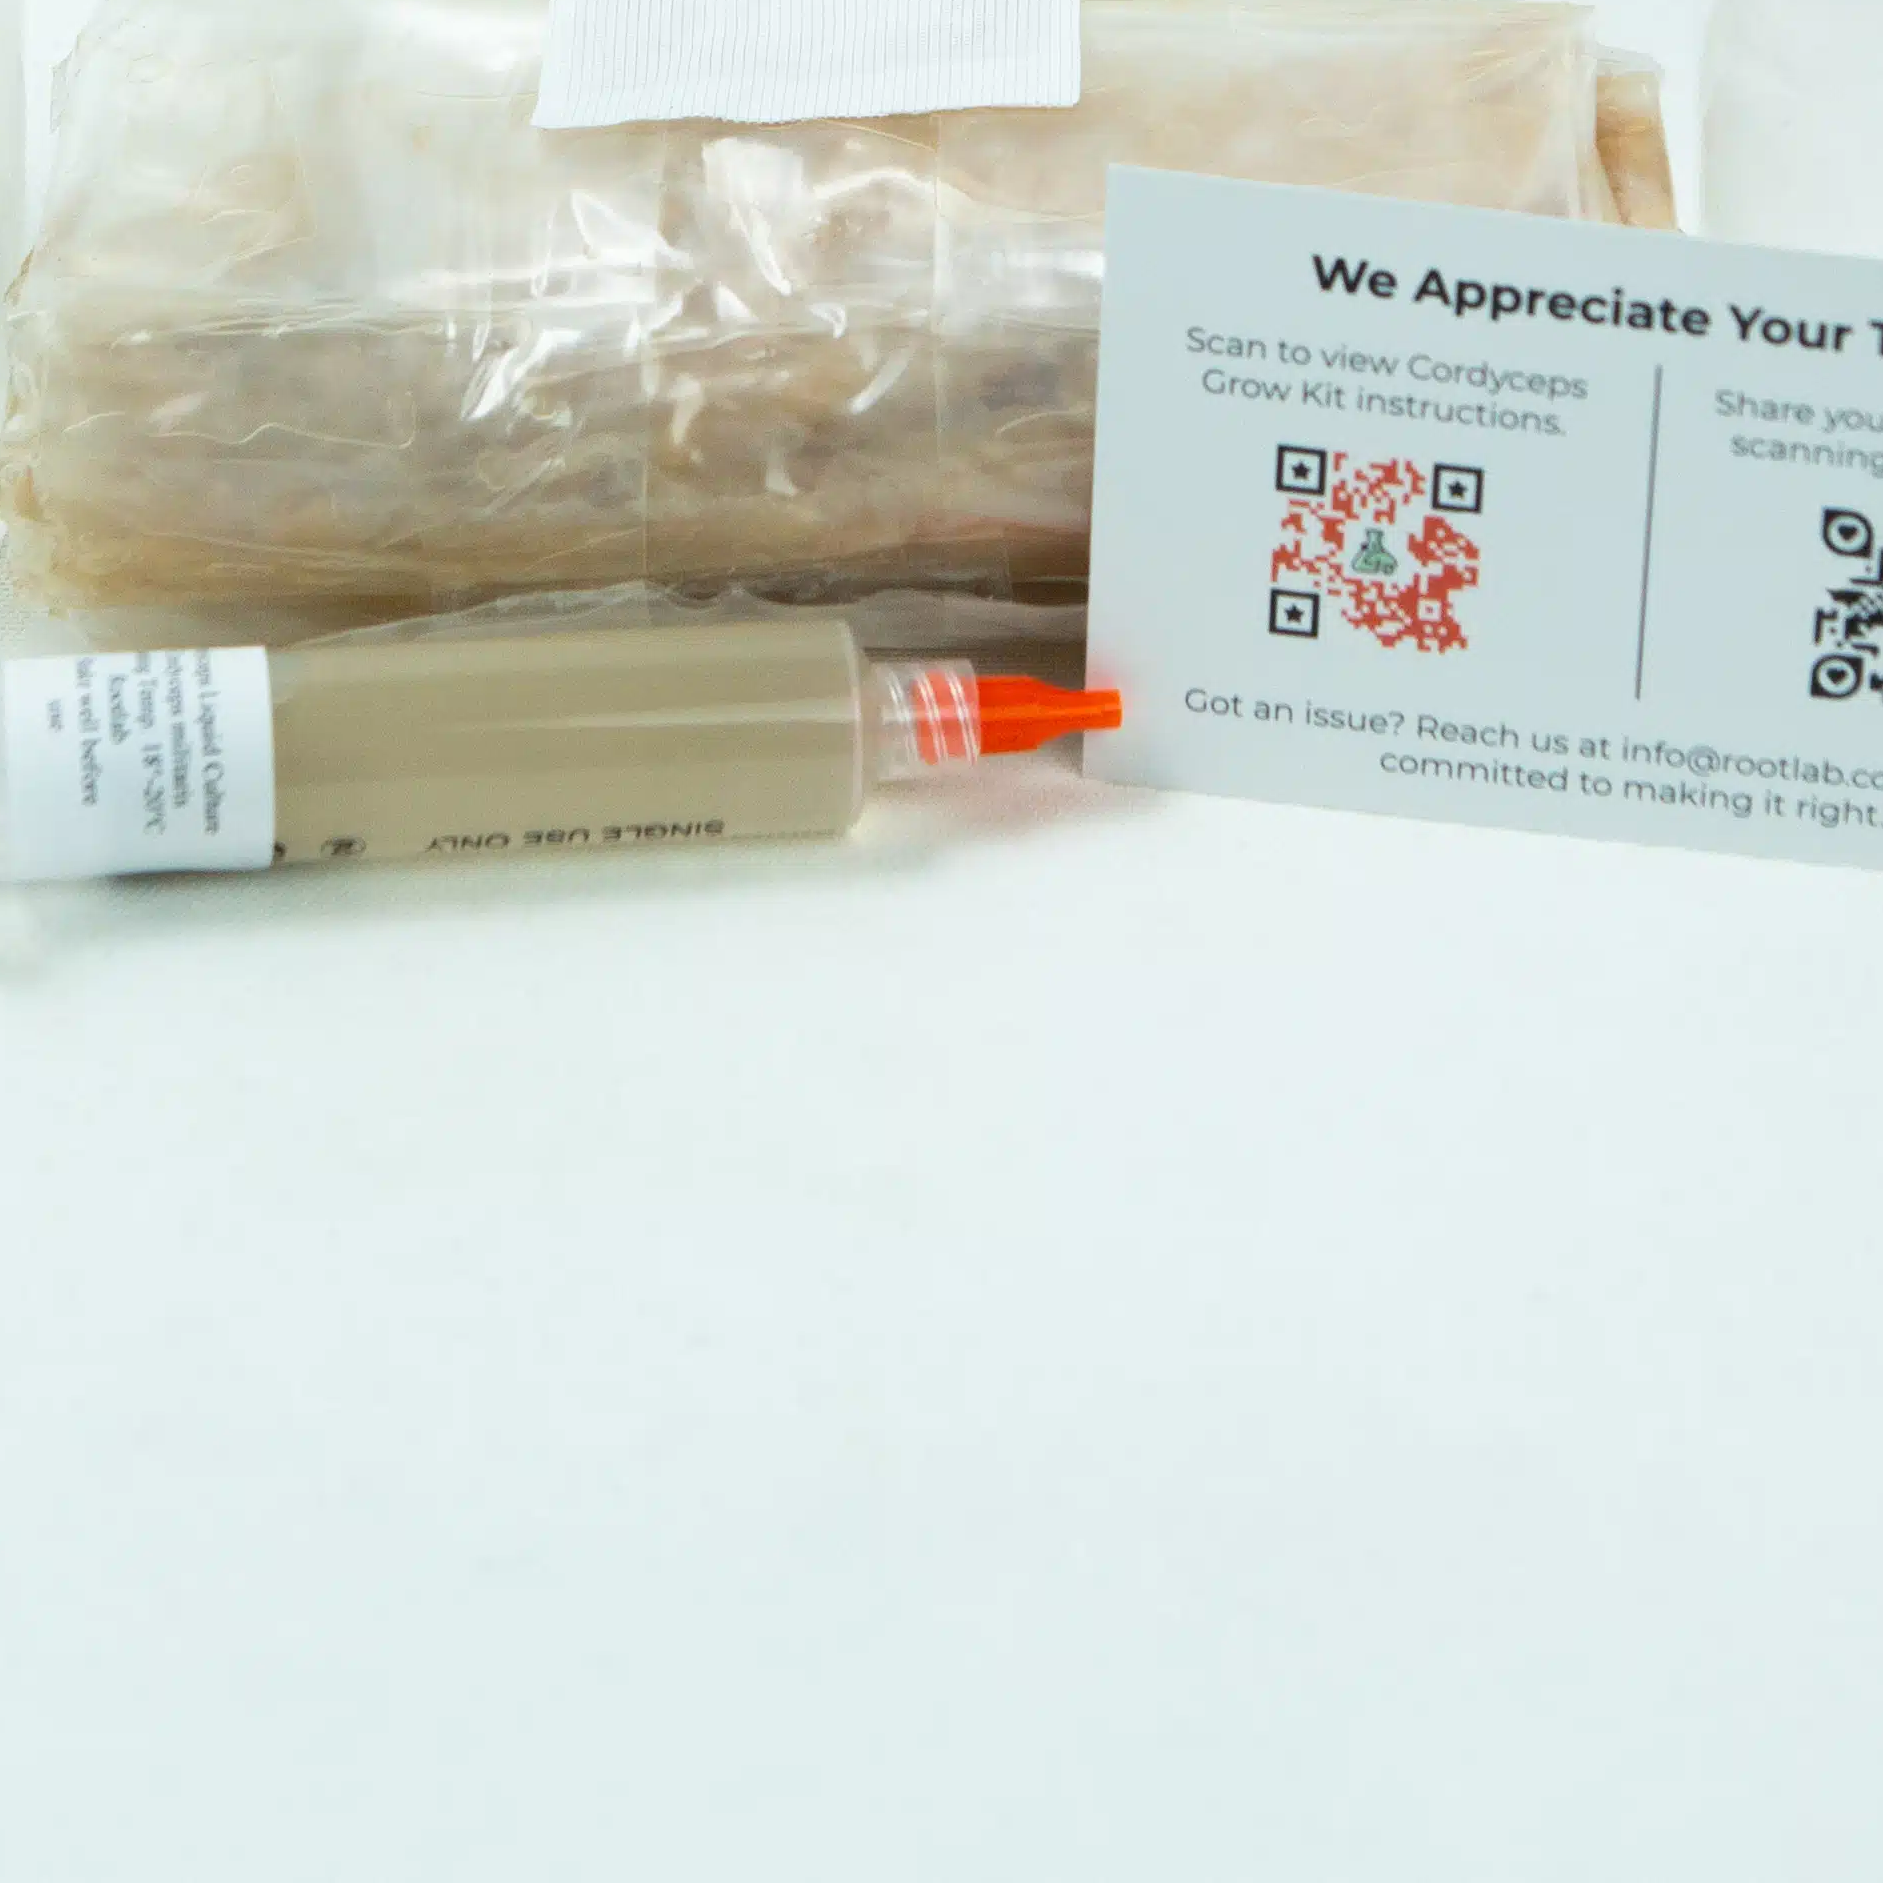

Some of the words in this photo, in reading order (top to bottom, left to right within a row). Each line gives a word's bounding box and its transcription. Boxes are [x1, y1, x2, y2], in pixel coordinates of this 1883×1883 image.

[1311, 253, 1398, 299] We
[1412, 267, 1711, 337] Appreciate
[1729, 303, 1853, 353] Your
[1186, 326, 1267, 361] Scan
[1277, 339, 1312, 367] to
[1320, 343, 1398, 378] view
[1406, 353, 1589, 403] Cordyceps
[1201, 367, 1292, 403] Grow
[1301, 380, 1346, 411] Kit
[1356, 387, 1567, 437] instructions.
[1715, 388, 1816, 426] Share
[1184, 687, 1243, 718] Got
[1253, 698, 1293, 723] an
[1305, 699, 1405, 735] issue?
[1416, 714, 1519, 749] Reach
[1531, 730, 1569, 756] us
[1579, 735, 1612, 761] at
[81, 737, 103, 806] before
[1379, 750, 1569, 792] committed
[1579, 770, 1612, 798] to
[1622, 775, 1753, 819] making
[1764, 789, 1787, 817] it
[423, 833, 511, 855] ONLY
[522, 828, 590, 850] USE
[601, 819, 725, 845] SINGLE
